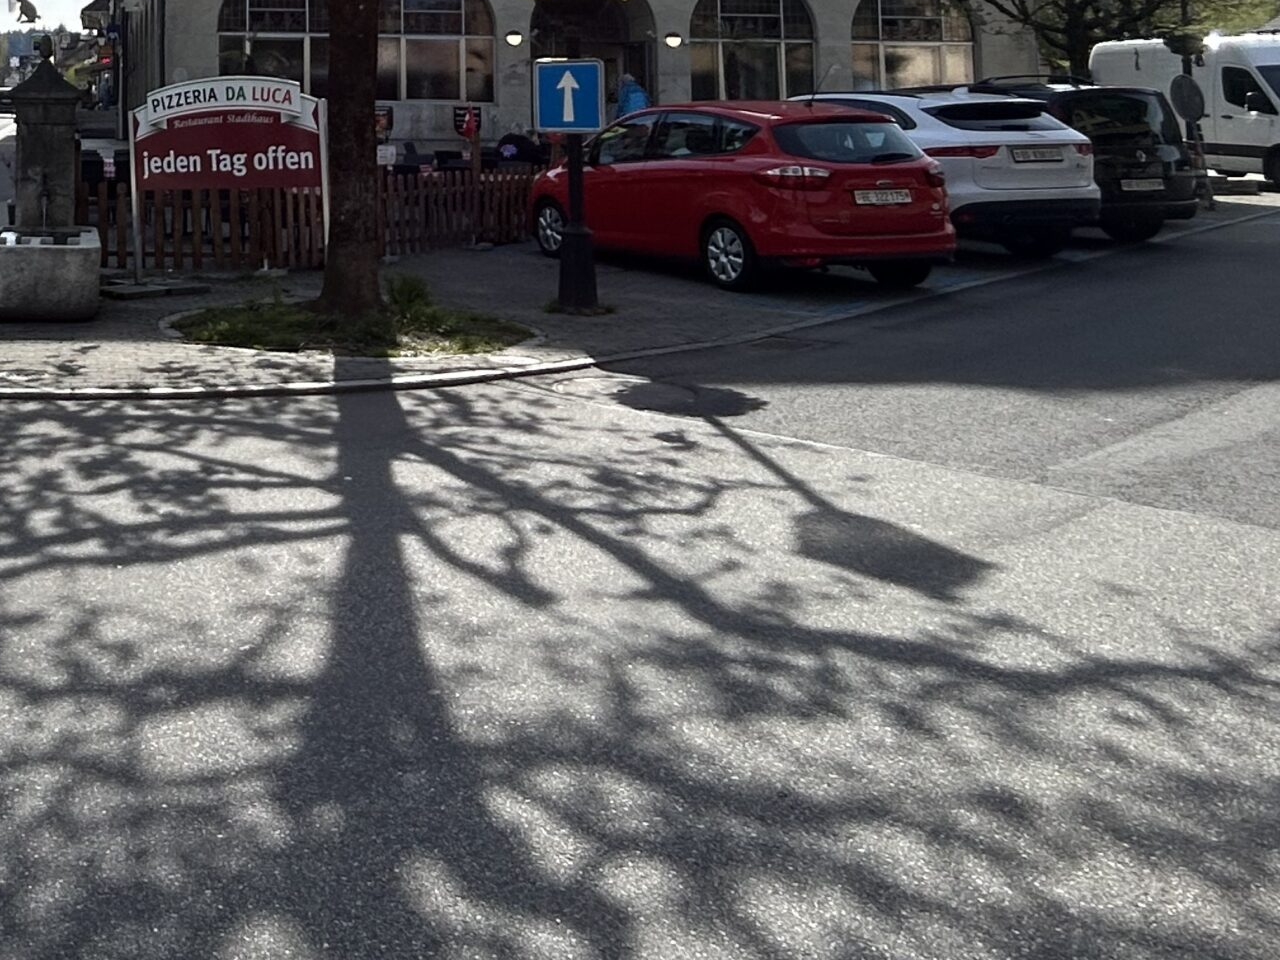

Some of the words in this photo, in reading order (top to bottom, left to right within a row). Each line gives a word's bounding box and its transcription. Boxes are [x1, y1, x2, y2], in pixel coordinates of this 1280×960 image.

[151, 87, 219, 113] PIZZERIA
[225, 86, 247, 101] DA
[251, 86, 293, 105] LUCA
[173, 114, 224, 129] Restaurant
[226, 112, 275, 124] Stadthaus
[142, 149, 202, 180] jeden
[206, 148, 248, 177] Tag
[253, 145, 314, 172] offen
